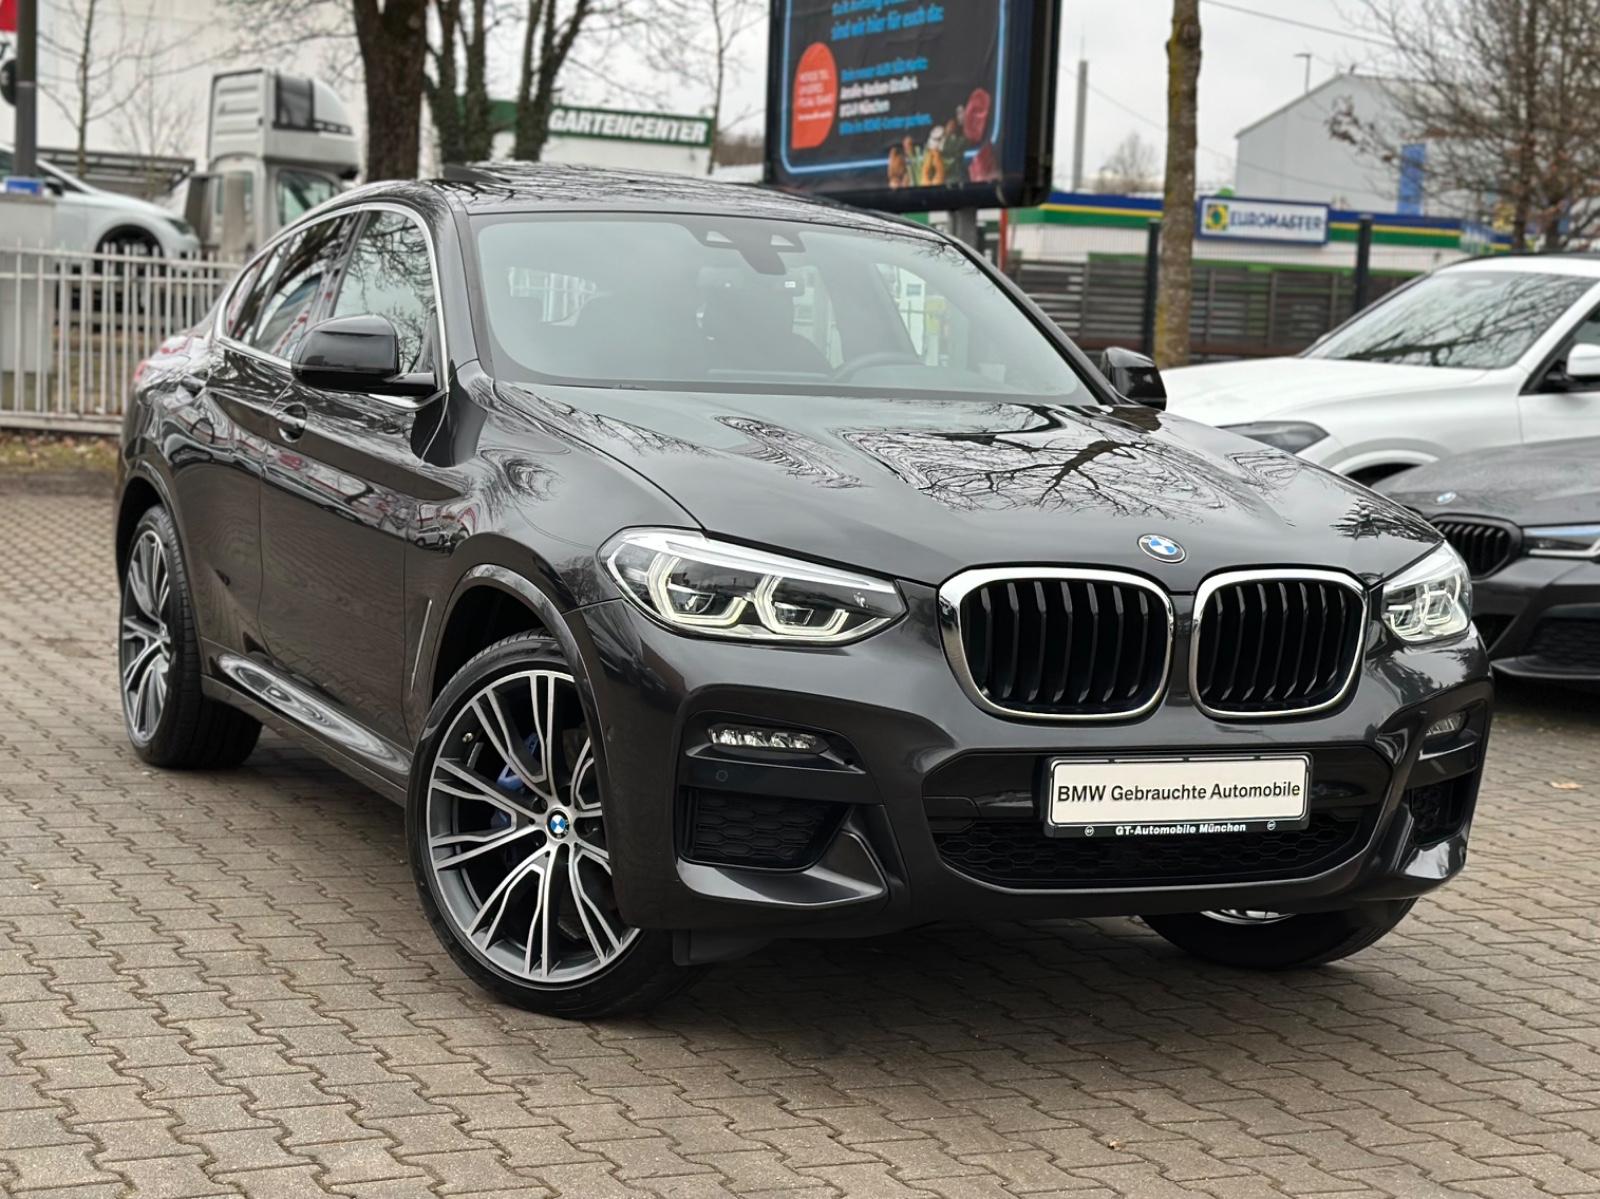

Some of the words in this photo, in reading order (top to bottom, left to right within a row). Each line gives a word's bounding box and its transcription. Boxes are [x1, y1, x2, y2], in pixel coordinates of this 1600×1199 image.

[549, 109, 707, 143] GARTENCENTER
[1231, 211, 1322, 230] EUROMASTER
[1057, 784, 1106, 802] BMW
[1111, 783, 1207, 801] Gebrauchte
[1210, 781, 1300, 799] Automobile
[1115, 824, 1196, 836] GT-Automobile
[1199, 823, 1246, 833] München
